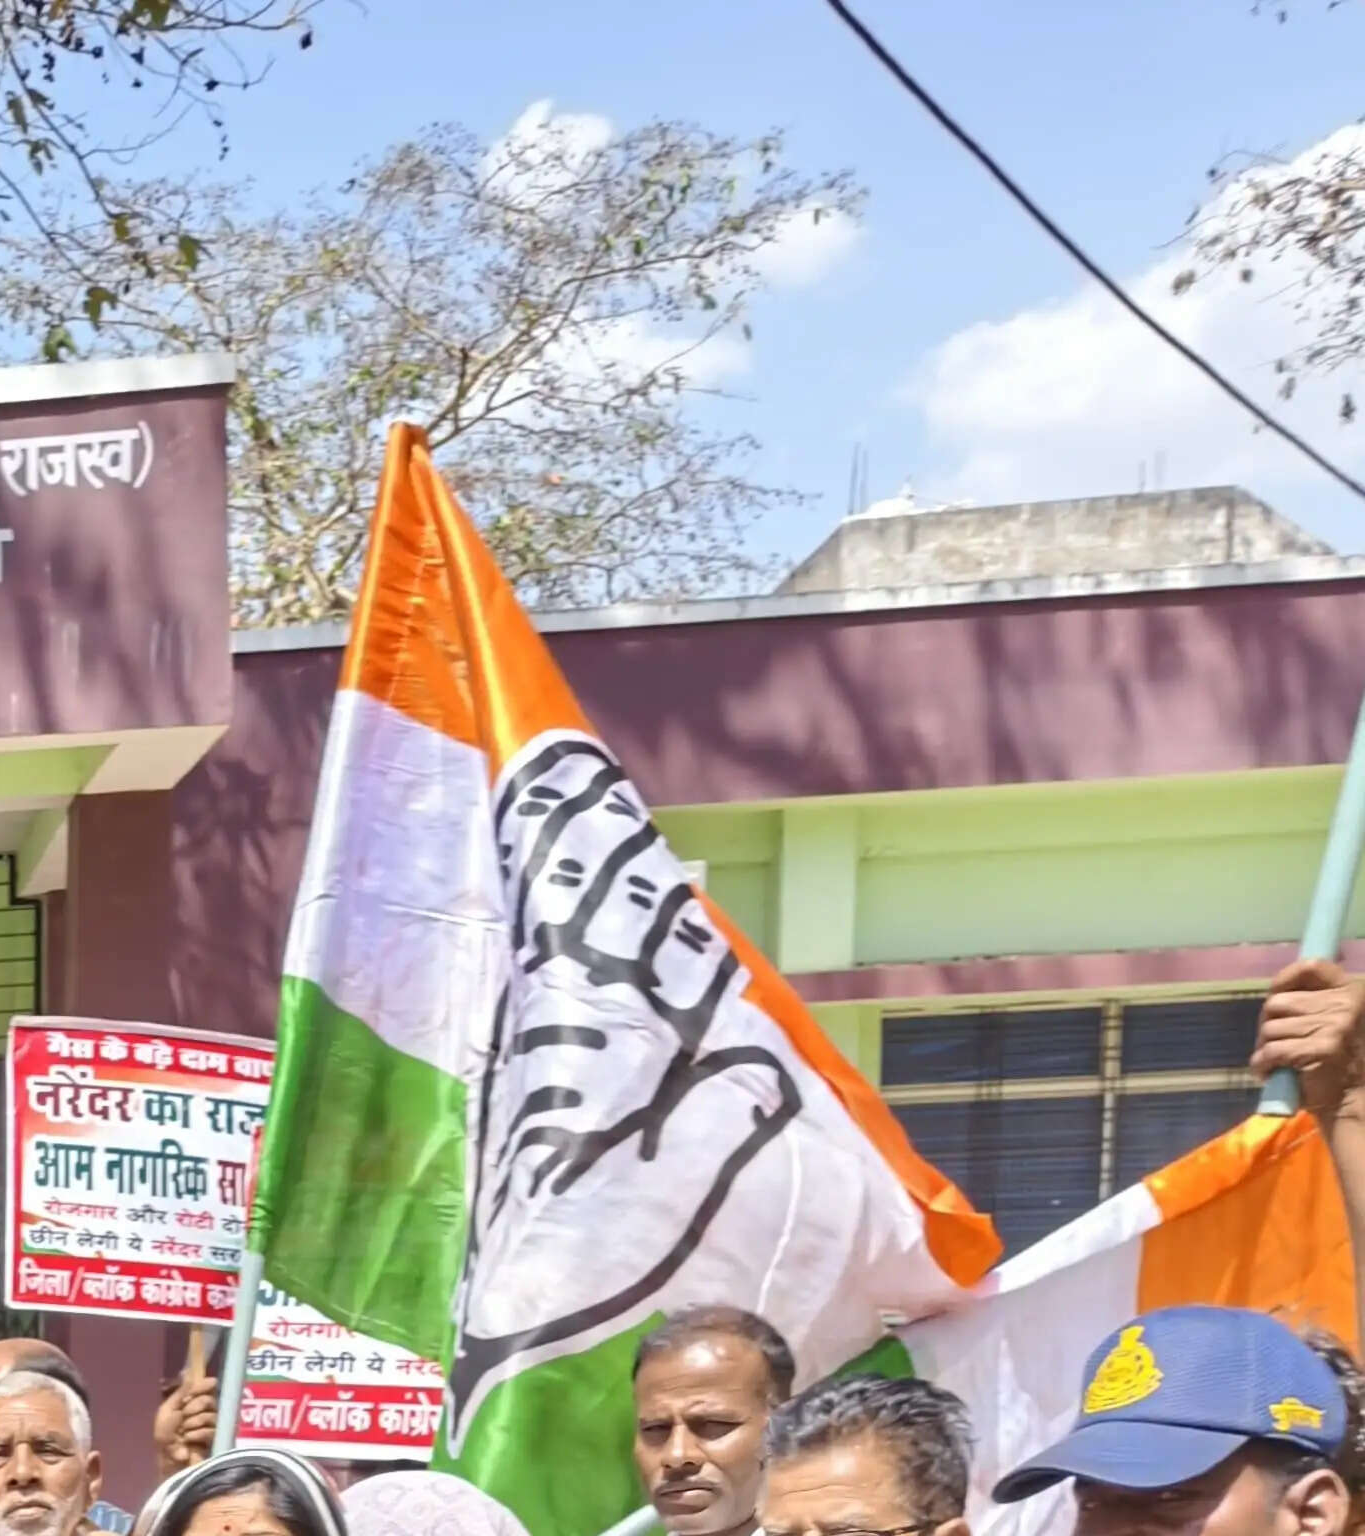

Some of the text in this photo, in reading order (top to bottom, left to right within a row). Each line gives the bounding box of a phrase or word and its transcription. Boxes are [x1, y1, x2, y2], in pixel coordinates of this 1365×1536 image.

[99, 1036, 128, 1059] के
[179, 1050, 227, 1073] दाम
[33, 1070, 135, 1123] नरेंदर
[143, 1089, 193, 1128] का
[35, 1141, 96, 1190] आम
[105, 1139, 208, 1201] नागरिक
[43, 1197, 119, 1220] रोजगार
[126, 1204, 167, 1224] और
[175, 1208, 215, 1230] रोटी
[29, 1229, 68, 1246] छीन
[77, 1229, 119, 1250] लेगी
[126, 1233, 143, 1251] ये
[150, 1236, 203, 1259] नरेंदर
[140, 1269, 201, 1308] कांग्रेस
[304, 1351, 356, 1373] लेगी
[366, 1352, 385, 1374] ये
